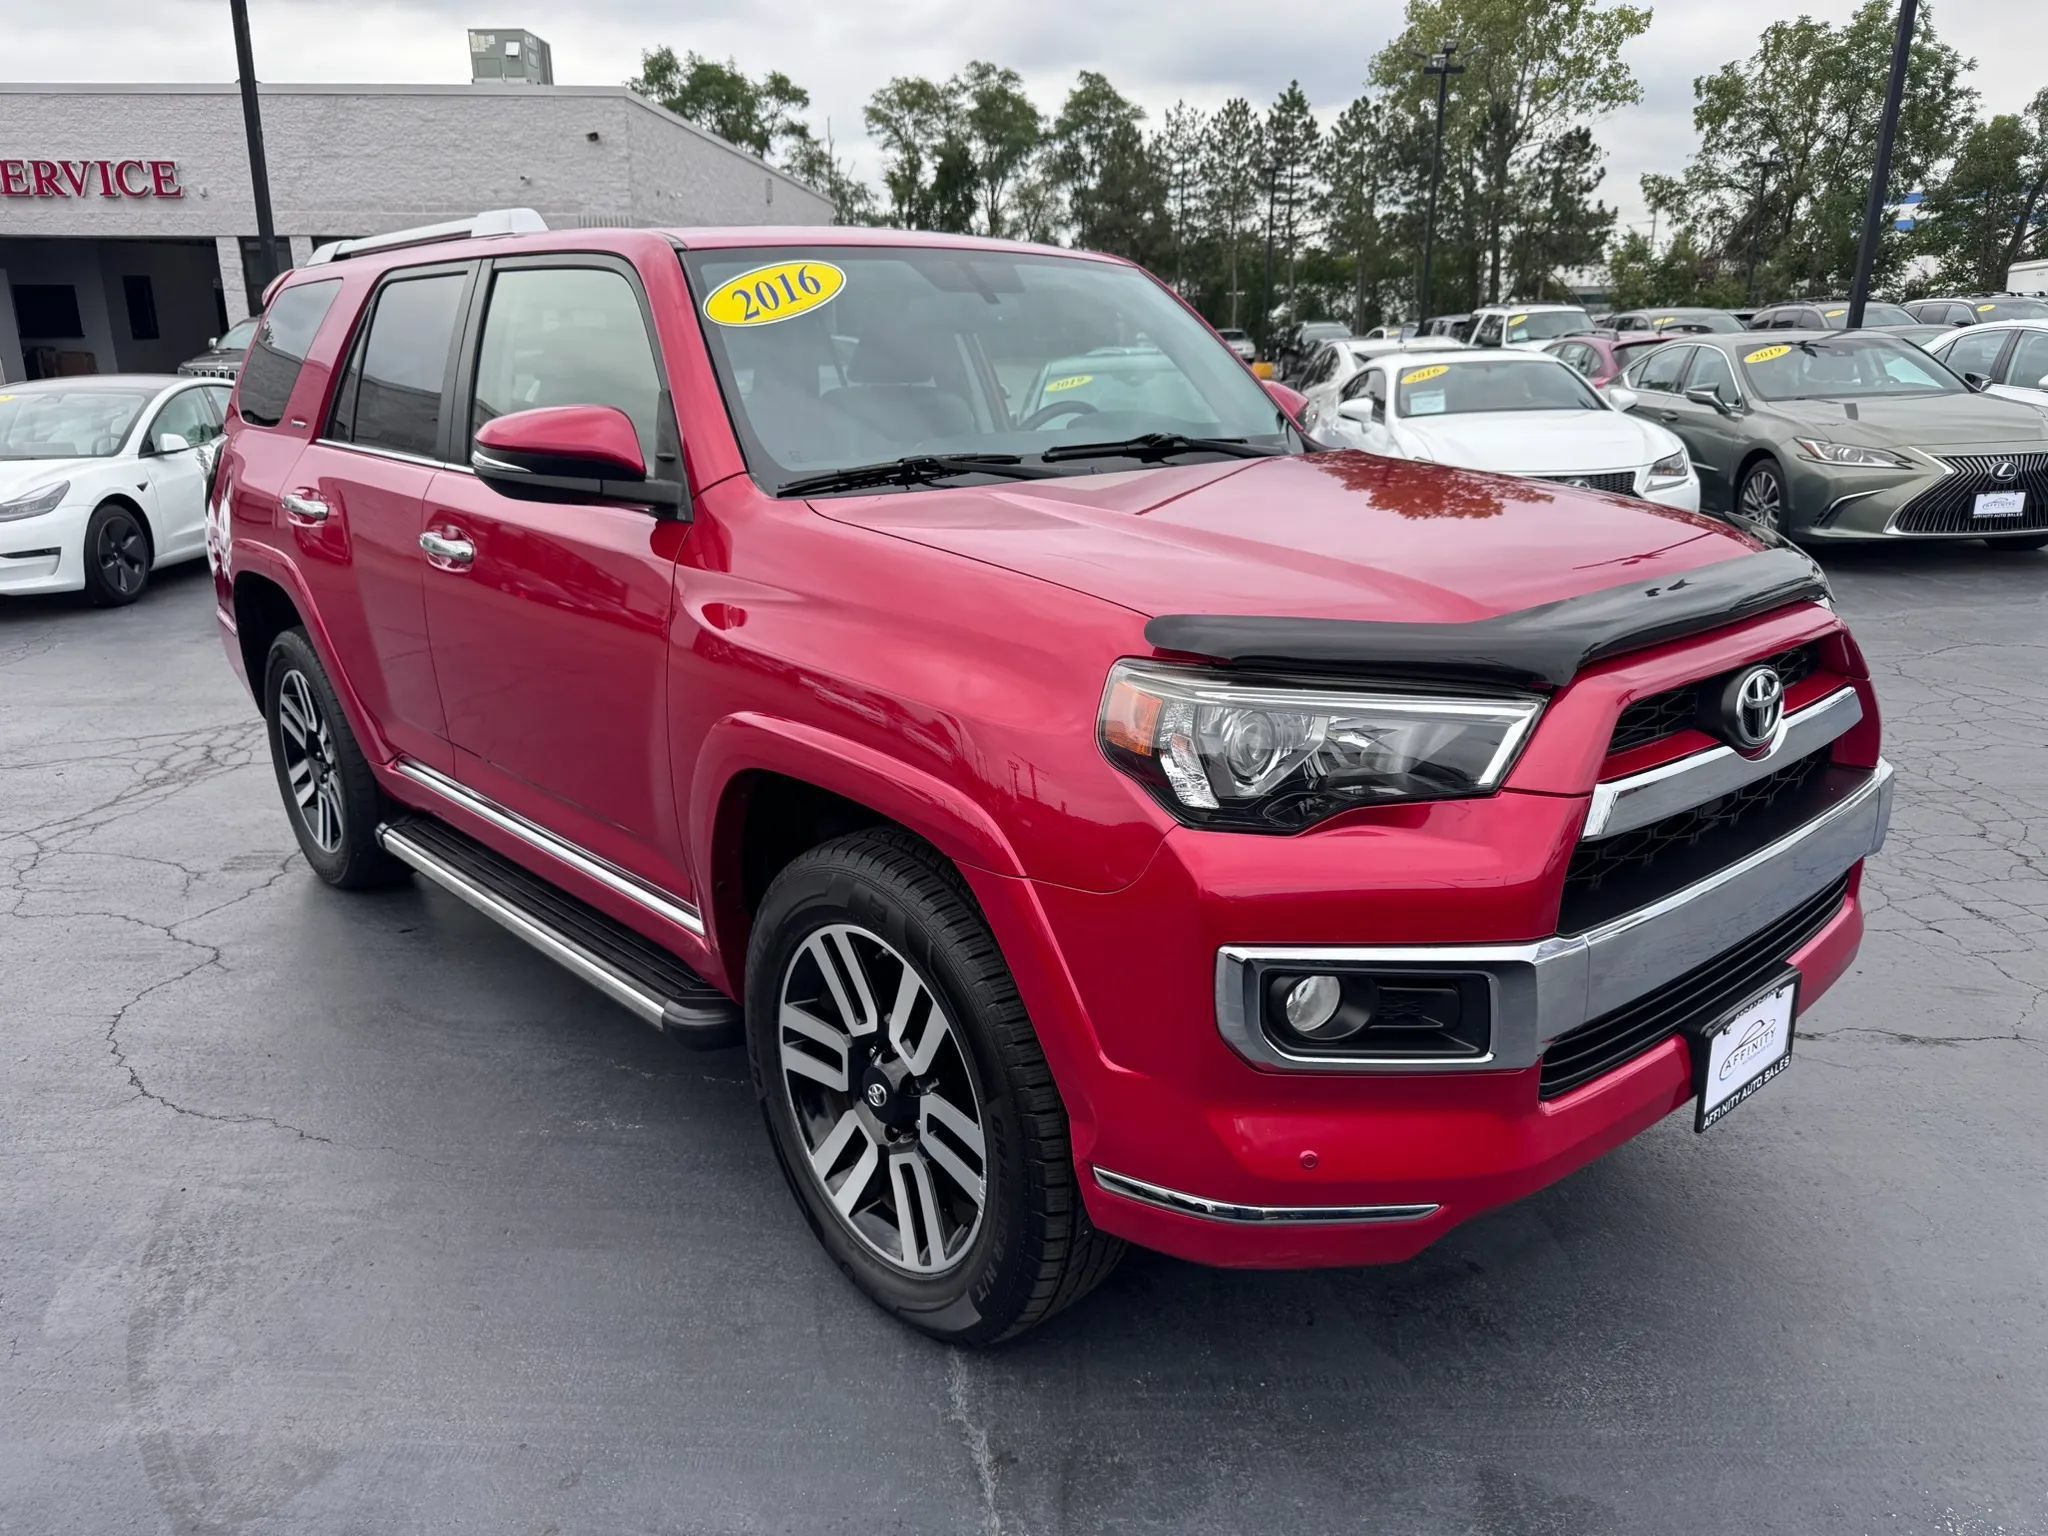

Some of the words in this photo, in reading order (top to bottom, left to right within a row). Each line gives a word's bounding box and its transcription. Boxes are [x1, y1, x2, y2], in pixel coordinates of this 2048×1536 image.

[0, 160, 184, 198] ERVICE
[731, 265, 821, 321] 2016
[1755, 347, 1782, 361] 2019
[1725, 1027, 1776, 1072] AFFINITY
[1703, 1092, 1741, 1129] AFFINITY
[1741, 1074, 1763, 1101] AUTO
[1764, 1055, 1790, 1083] SALES
